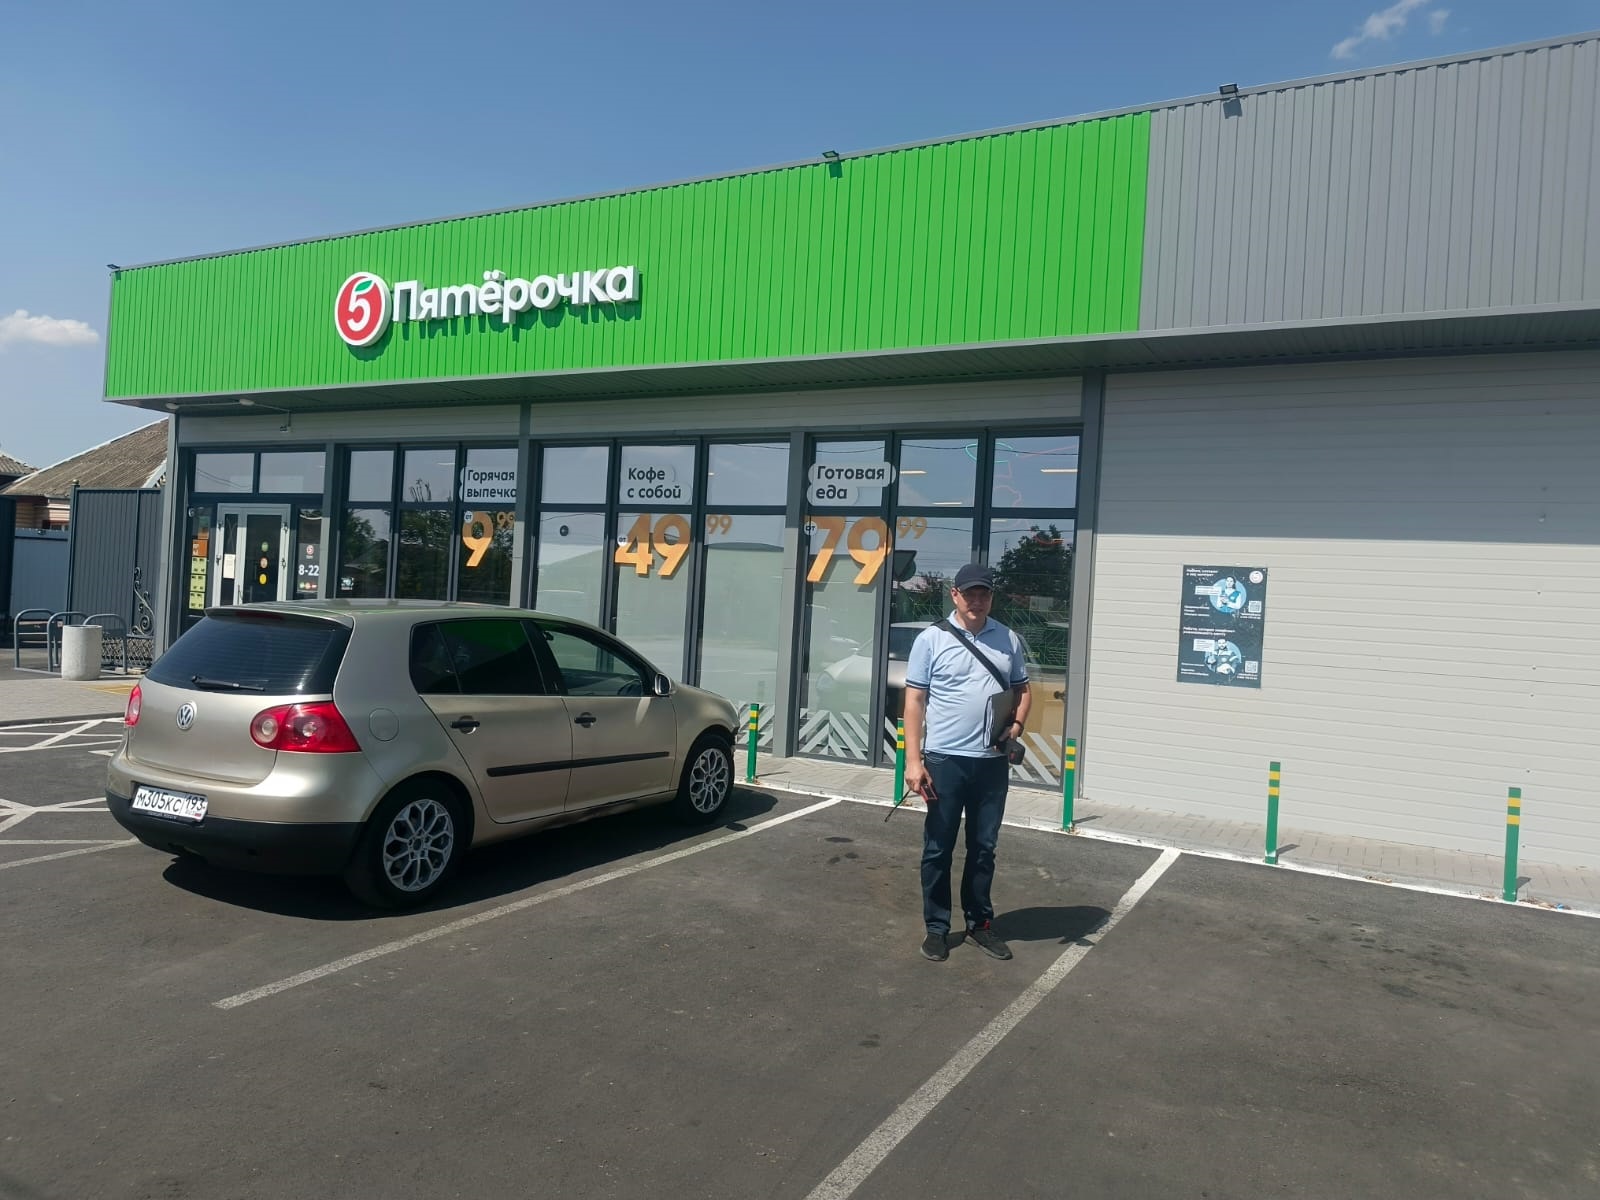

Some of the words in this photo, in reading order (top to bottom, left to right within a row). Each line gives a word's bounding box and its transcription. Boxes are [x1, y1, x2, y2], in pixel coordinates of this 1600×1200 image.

[393, 265, 639, 324] Пятёрочка
[467, 469, 515, 484] Горячая
[628, 466, 666, 484] Кофе
[817, 465, 885, 480] Готовая
[627, 487, 635, 498] с
[638, 485, 682, 499] собой
[815, 485, 848, 500] еда
[462, 511, 494, 567] 9
[614, 513, 692, 576] 49
[706, 514, 733, 536] 99
[804, 516, 893, 585] 79
[896, 516, 928, 541] 99
[298, 564, 320, 577] 8-22
